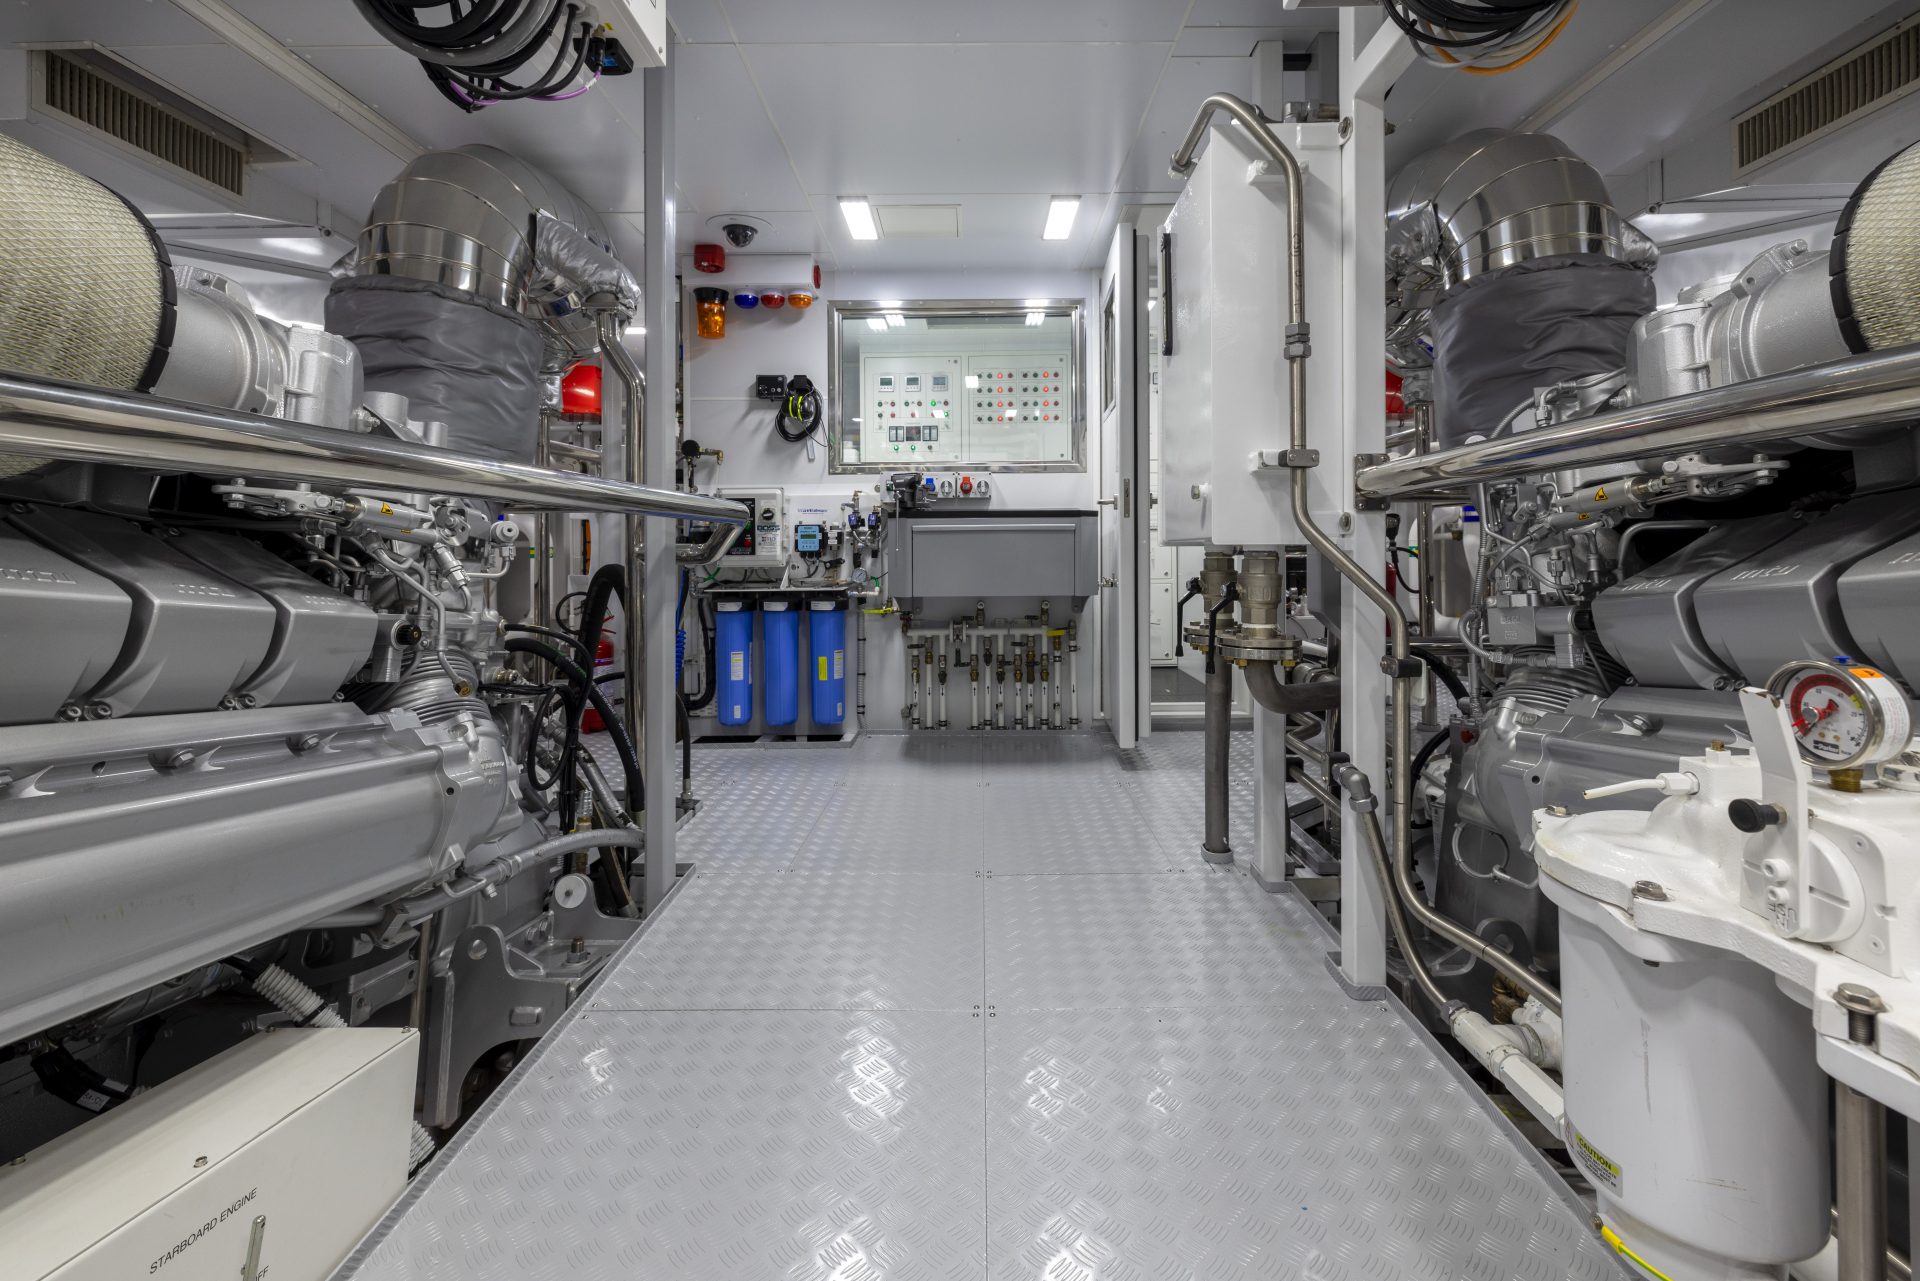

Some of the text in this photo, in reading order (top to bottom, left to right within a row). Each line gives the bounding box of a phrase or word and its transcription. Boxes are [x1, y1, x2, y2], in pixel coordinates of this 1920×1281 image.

[1578, 1138, 1612, 1170] CAUTION
[149, 1187, 258, 1275] STARBOARD ENGINE
[255, 1264, 270, 1281] FF
